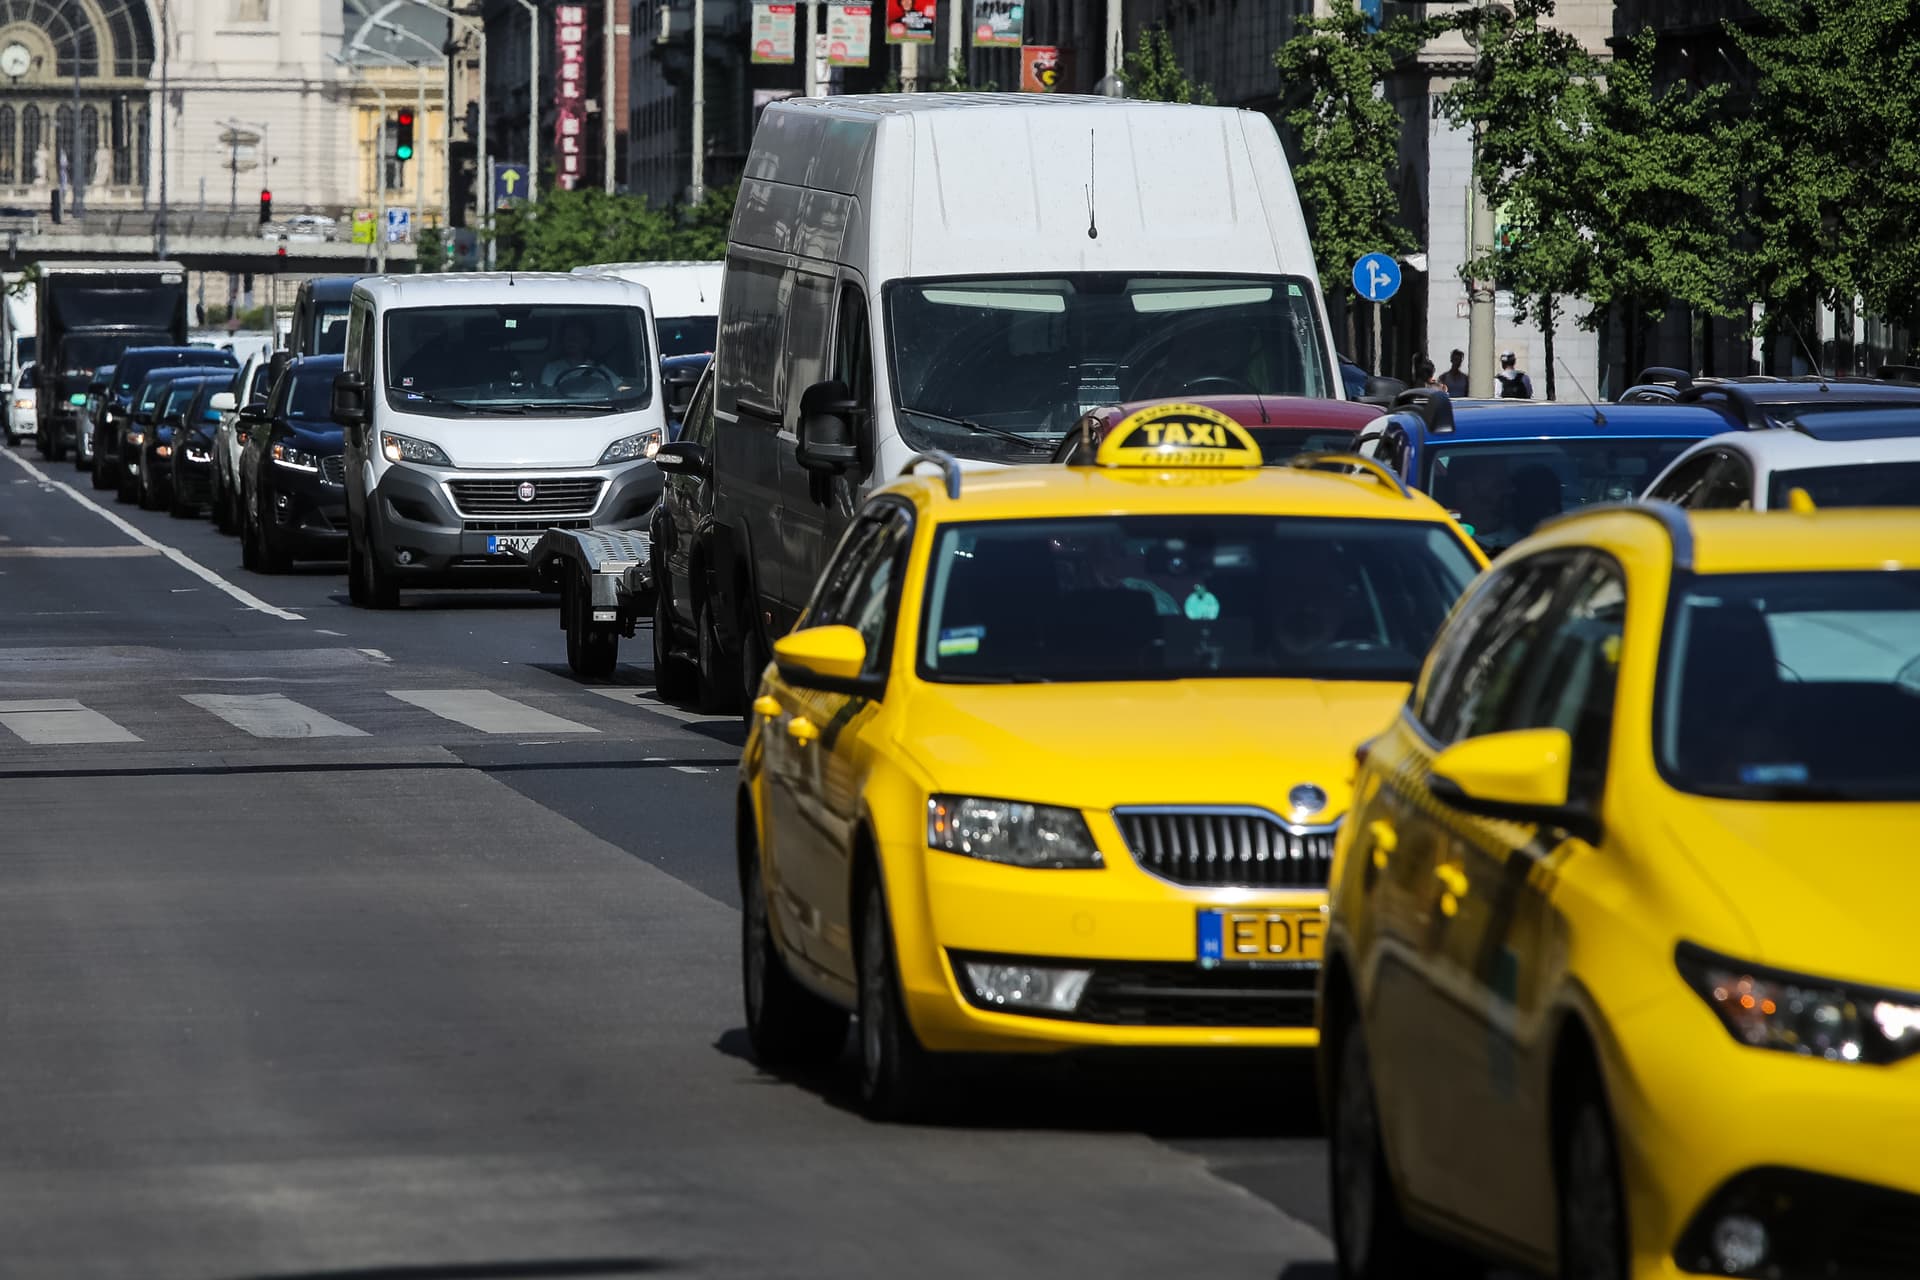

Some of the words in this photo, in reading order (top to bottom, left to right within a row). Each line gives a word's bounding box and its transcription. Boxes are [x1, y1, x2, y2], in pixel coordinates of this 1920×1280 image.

[560, 6, 582, 98] HOTEL
[1141, 423, 1228, 447] TAXI
[1233, 914, 1321, 954] EDF
